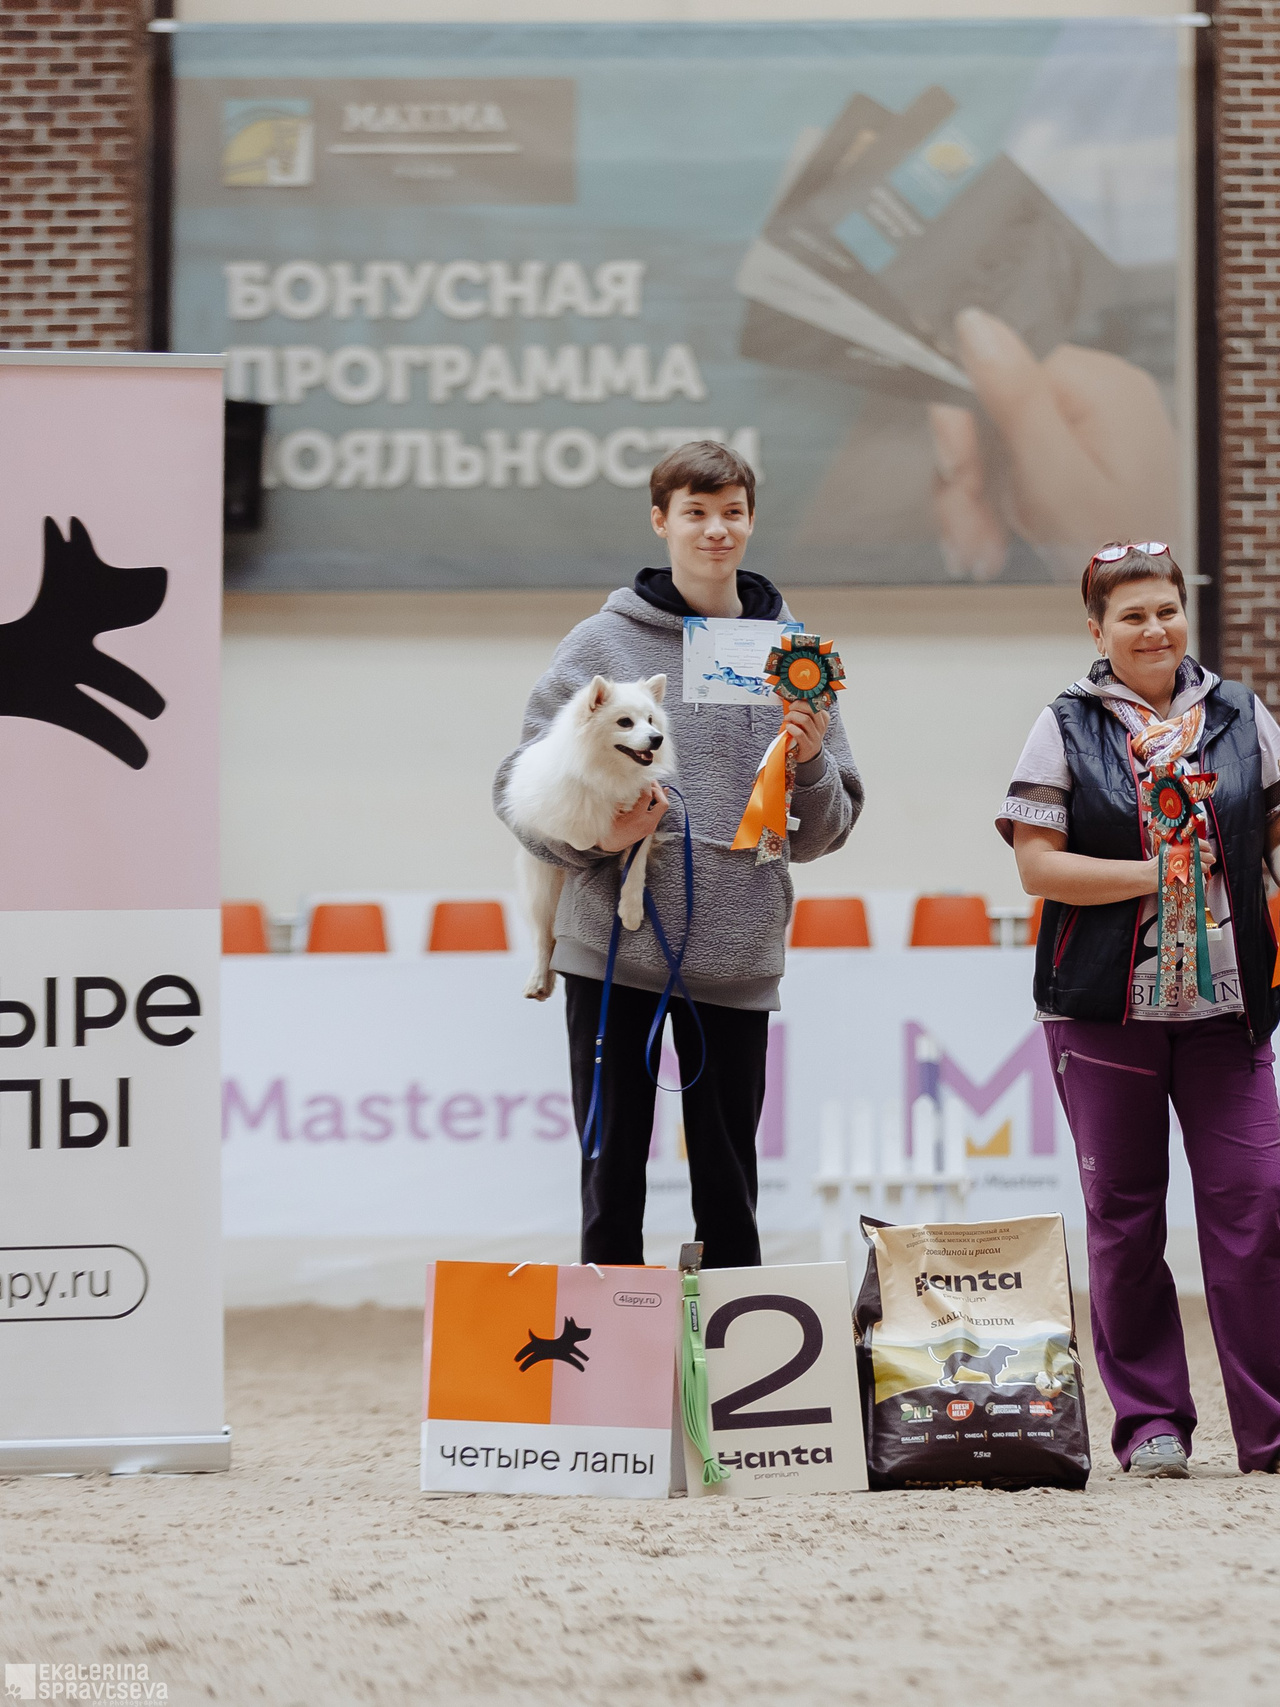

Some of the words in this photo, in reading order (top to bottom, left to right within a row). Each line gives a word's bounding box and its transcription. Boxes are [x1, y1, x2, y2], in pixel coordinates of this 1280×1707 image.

[225, 261, 645, 320] БОНУСНАЯ
[226, 344, 706, 402] ПРОГРАММА
[264, 427, 764, 490] ОЯЛЬНОС
[1005, 802, 1066, 823] VALUAB
[221, 1076, 571, 1143] Masters
[974, 1248, 1001, 1257] рисом
[618, 1295, 655, 1305] 4lapy.ru
[705, 1294, 833, 1431] 2
[440, 1445, 561, 1471] четыре
[569, 1451, 655, 1475] лапы
[718, 1445, 833, 1470] Hanta
[754, 1471, 799, 1480] premium
